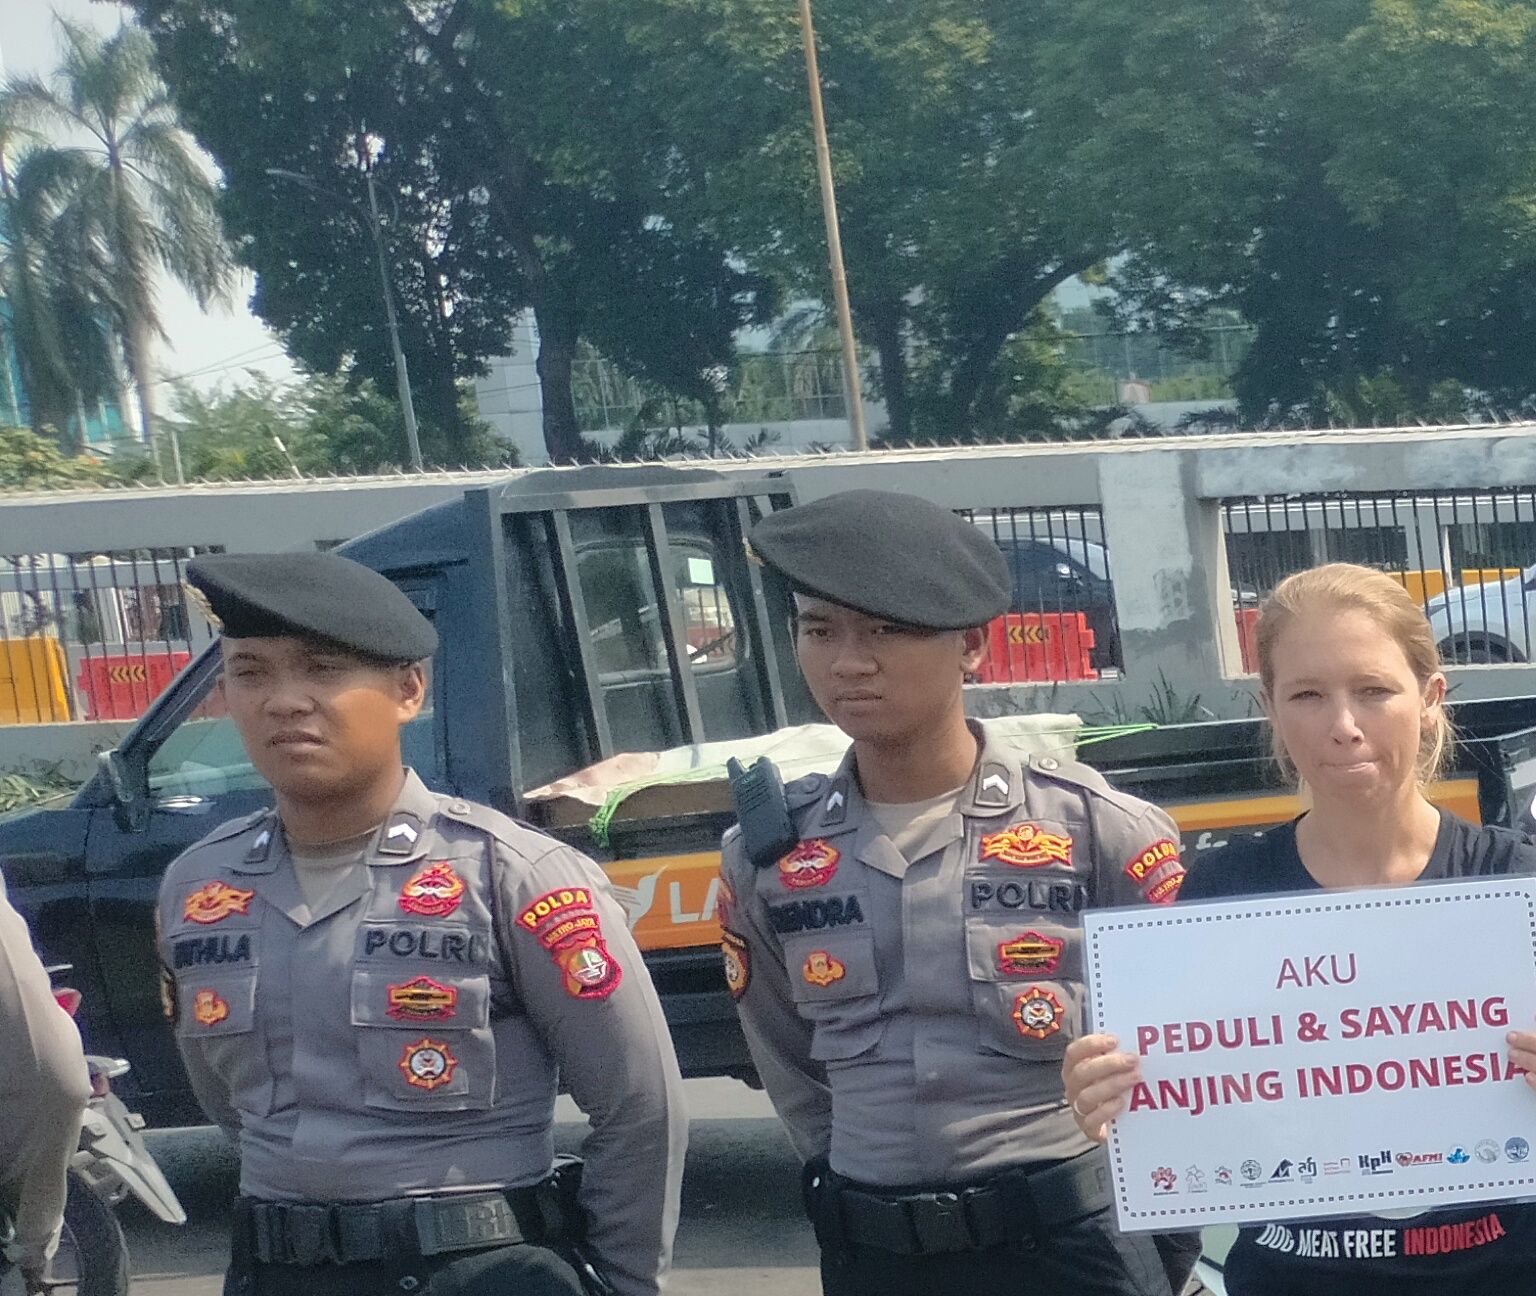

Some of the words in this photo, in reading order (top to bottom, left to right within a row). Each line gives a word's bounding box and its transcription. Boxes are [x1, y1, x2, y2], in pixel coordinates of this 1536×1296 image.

[523, 889, 588, 927] POLDA
[971, 881, 1083, 913] POLRI
[365, 930, 488, 962] POLRI
[1275, 952, 1359, 990] AKU
[1137, 1014, 1283, 1056] PEDULI
[1297, 1011, 1327, 1043] &
[1340, 996, 1509, 1039] SAYANG
[1129, 1068, 1283, 1116] ANJING
[1296, 1229, 1340, 1258] MEAT
[1343, 1229, 1396, 1258] FREE
[1403, 1213, 1506, 1256] INDONESIA
